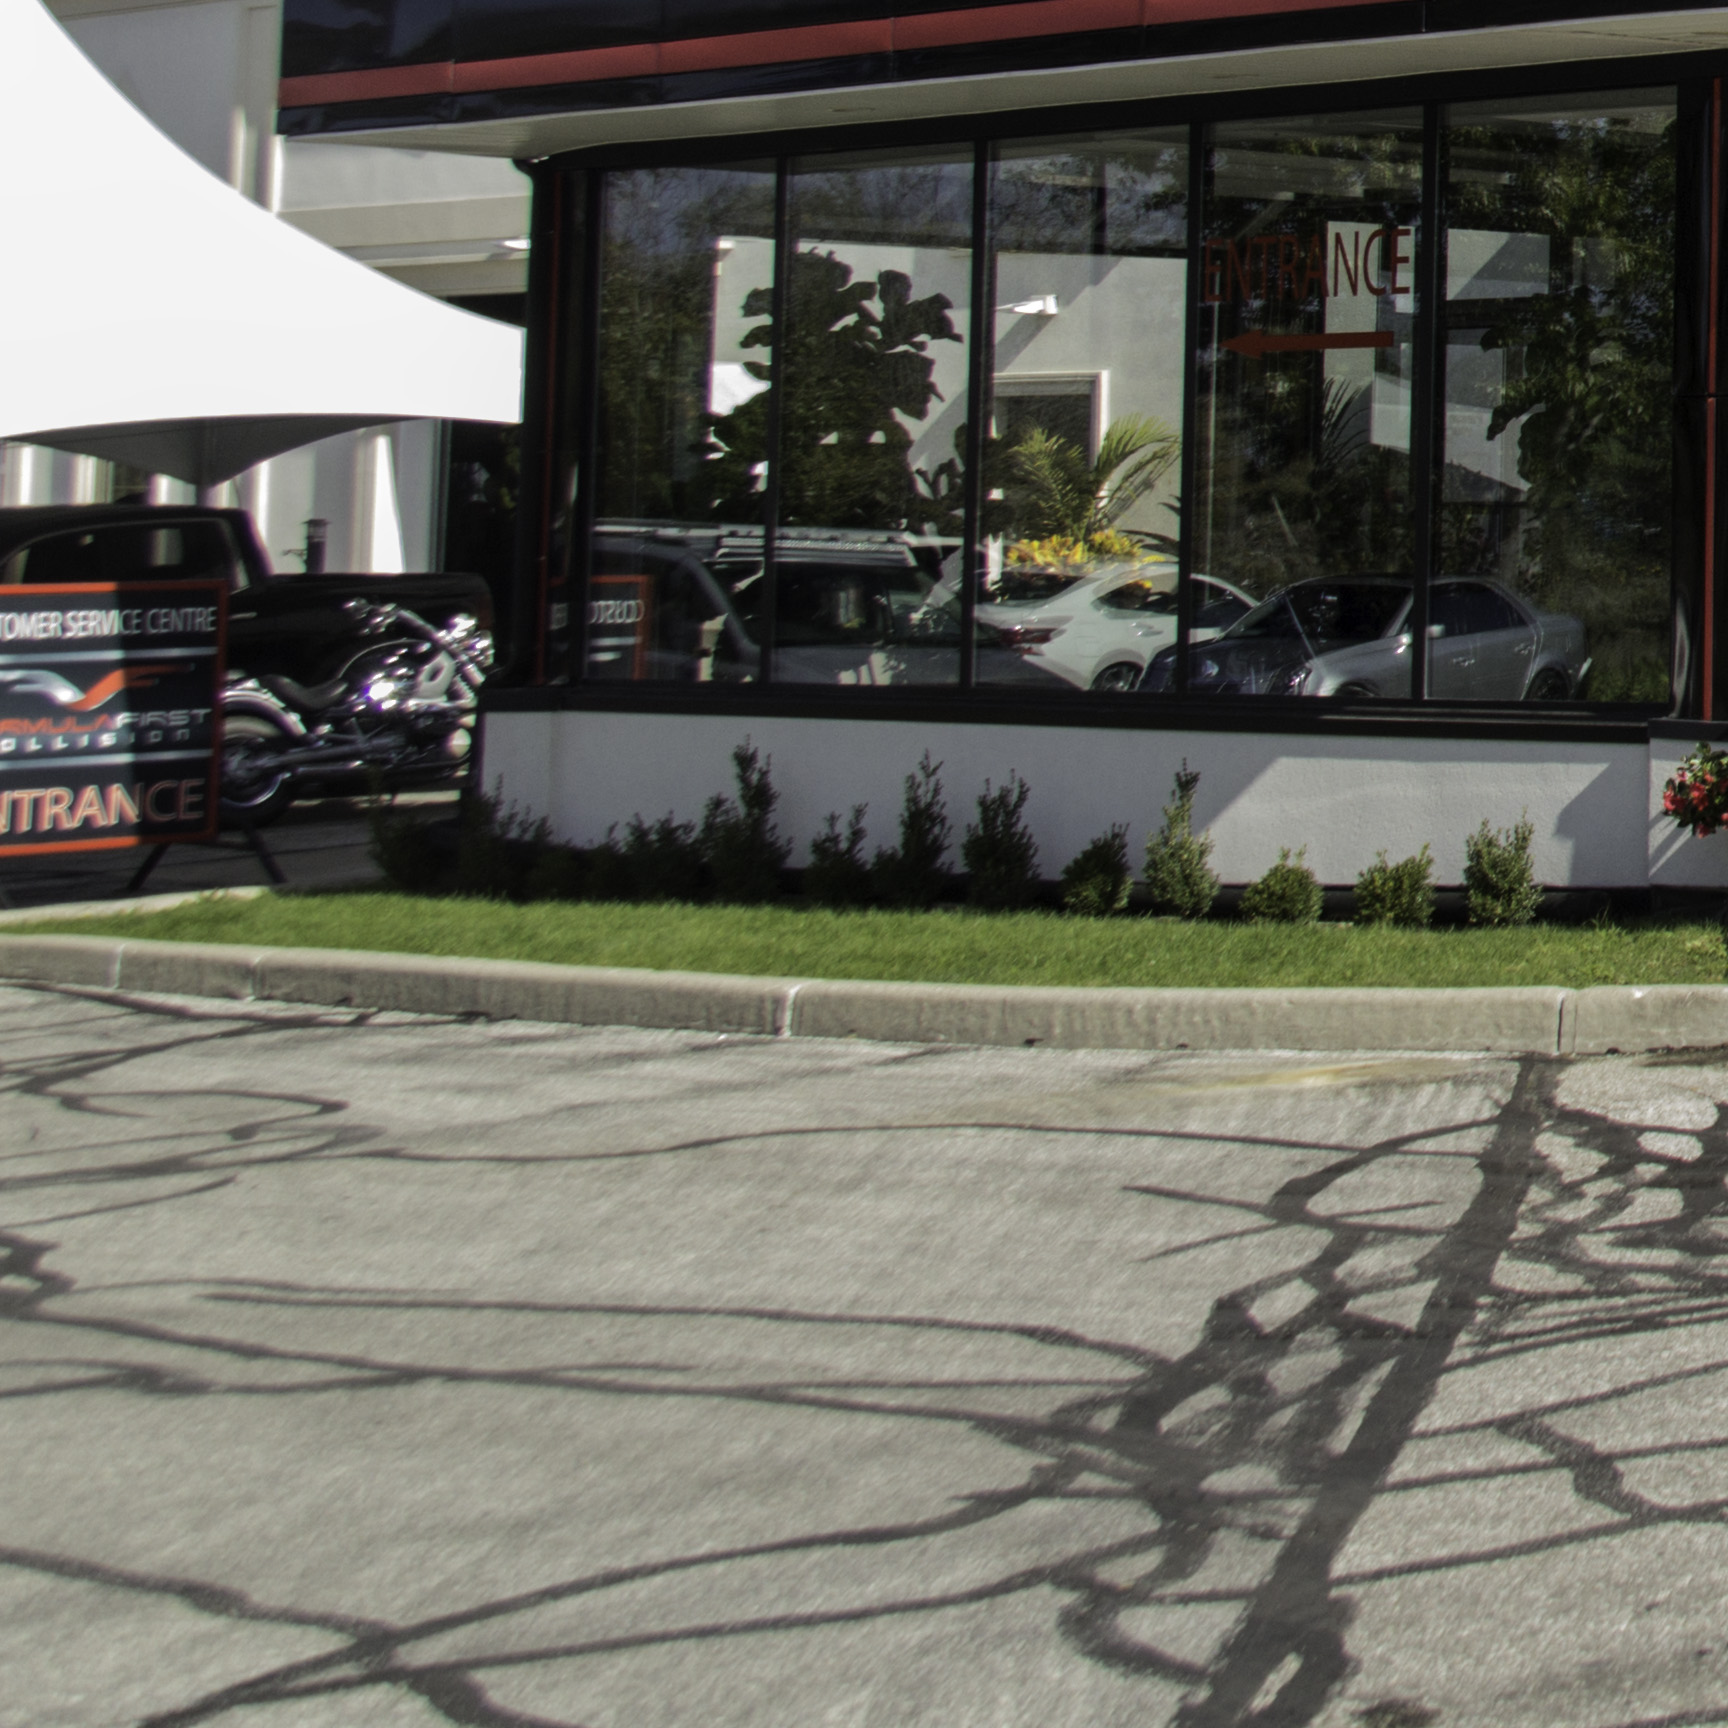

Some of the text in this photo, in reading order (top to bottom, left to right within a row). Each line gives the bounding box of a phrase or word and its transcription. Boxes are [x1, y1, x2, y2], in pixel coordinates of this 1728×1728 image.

[1203, 229, 1412, 302] ENTRANCE
[63, 609, 144, 640] SERVICE
[146, 606, 218, 635] CENTRE
[111, 708, 213, 731] FIRST
